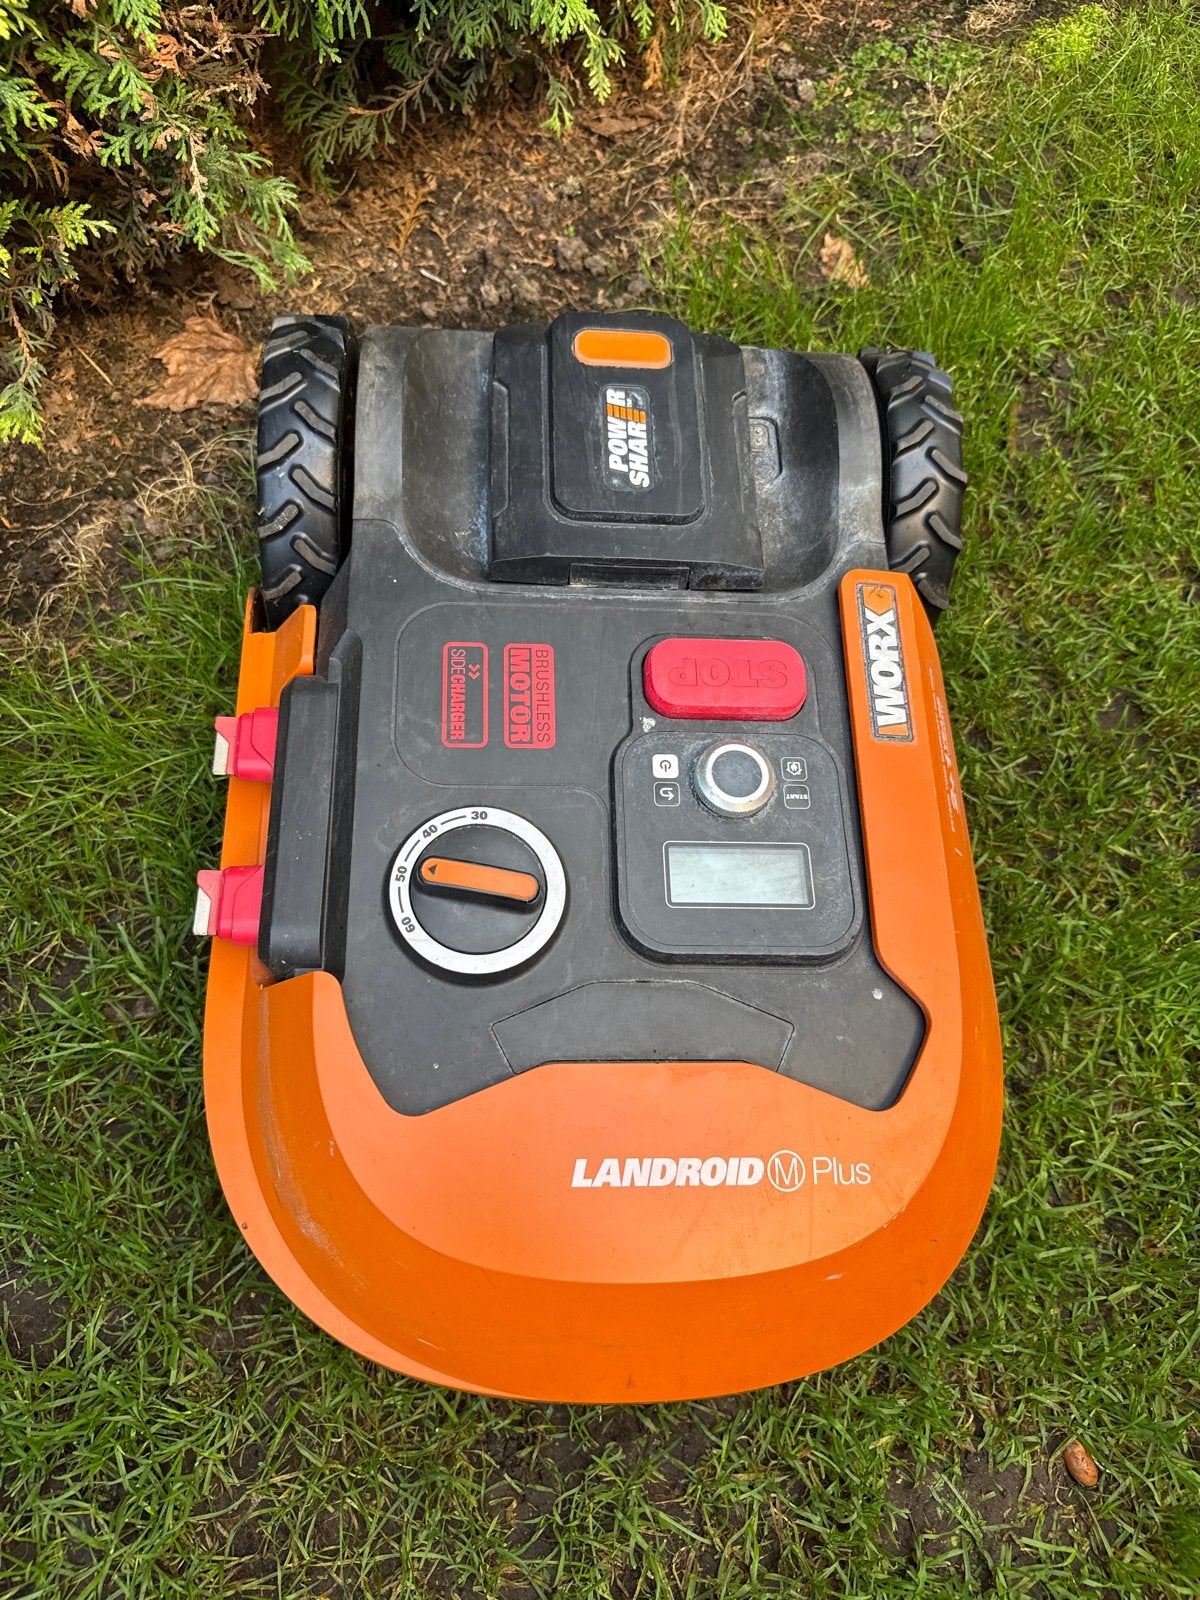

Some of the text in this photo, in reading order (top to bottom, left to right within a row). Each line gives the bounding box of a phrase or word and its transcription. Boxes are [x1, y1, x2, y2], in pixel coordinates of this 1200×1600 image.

[668, 657, 788, 689] STOP
[864, 606, 907, 727] WORX
[450, 648, 466, 740] SIDECHARGER
[510, 649, 531, 742] MOTOR
[536, 649, 551, 743] BRUSHLESS
[471, 811, 488, 820] 30
[422, 824, 438, 839] 40
[395, 865, 408, 883] 50
[401, 916, 416, 933] 60
[571, 1157, 765, 1187] LANDROID
[812, 1156, 872, 1185] Plus
